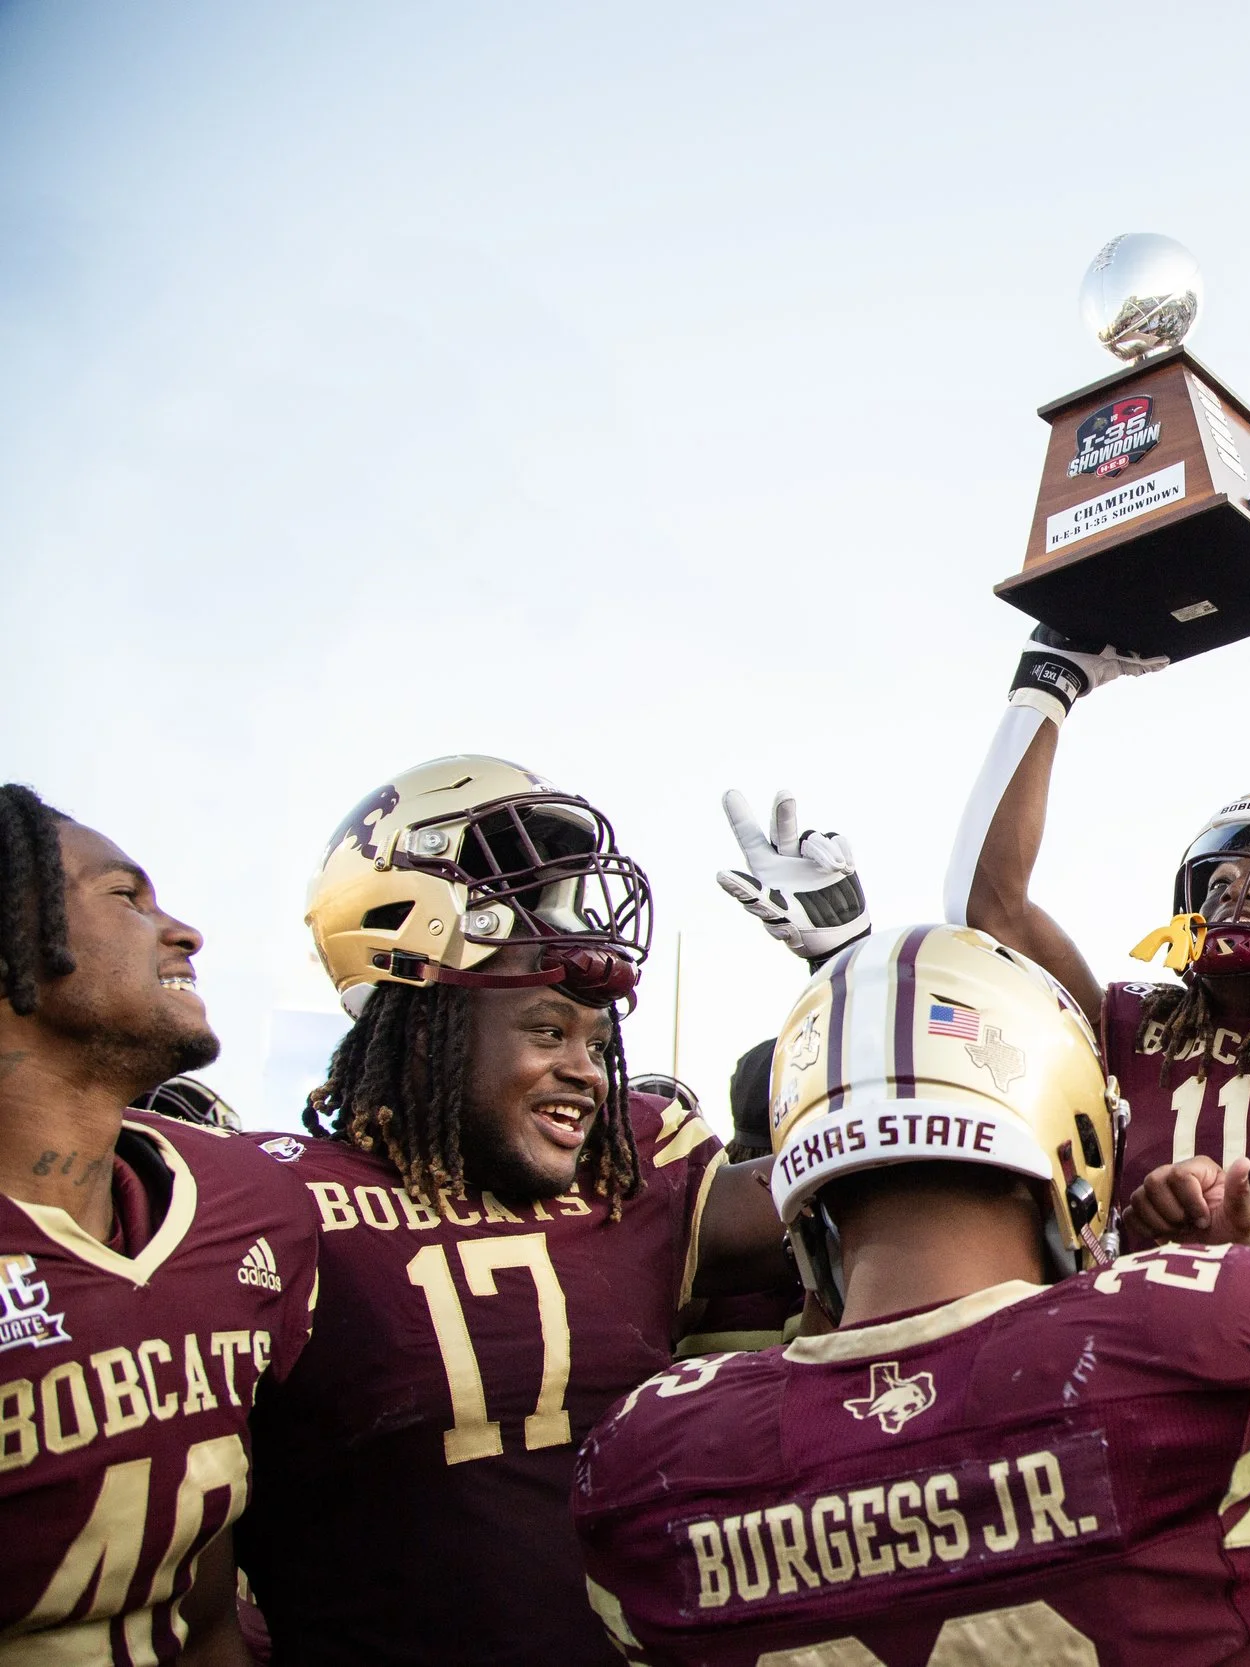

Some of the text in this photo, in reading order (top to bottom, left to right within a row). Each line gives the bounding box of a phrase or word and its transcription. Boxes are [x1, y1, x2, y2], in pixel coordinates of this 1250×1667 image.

[1068, 422, 1160, 476] SHOWDOWN
[1080, 412, 1147, 456] I-35
[1052, 485, 1179, 544] H-E-B I-35 SHOWDOWN
[1074, 480, 1156, 522] CHAMPION
[1042, 669, 1058, 681] 3XL
[780, 1115, 996, 1185] TEXAS STATE
[237, 1266, 282, 1292] adidas
[407, 1233, 571, 1465] 17
[688, 1450, 1099, 1608] BURGESS JR.
